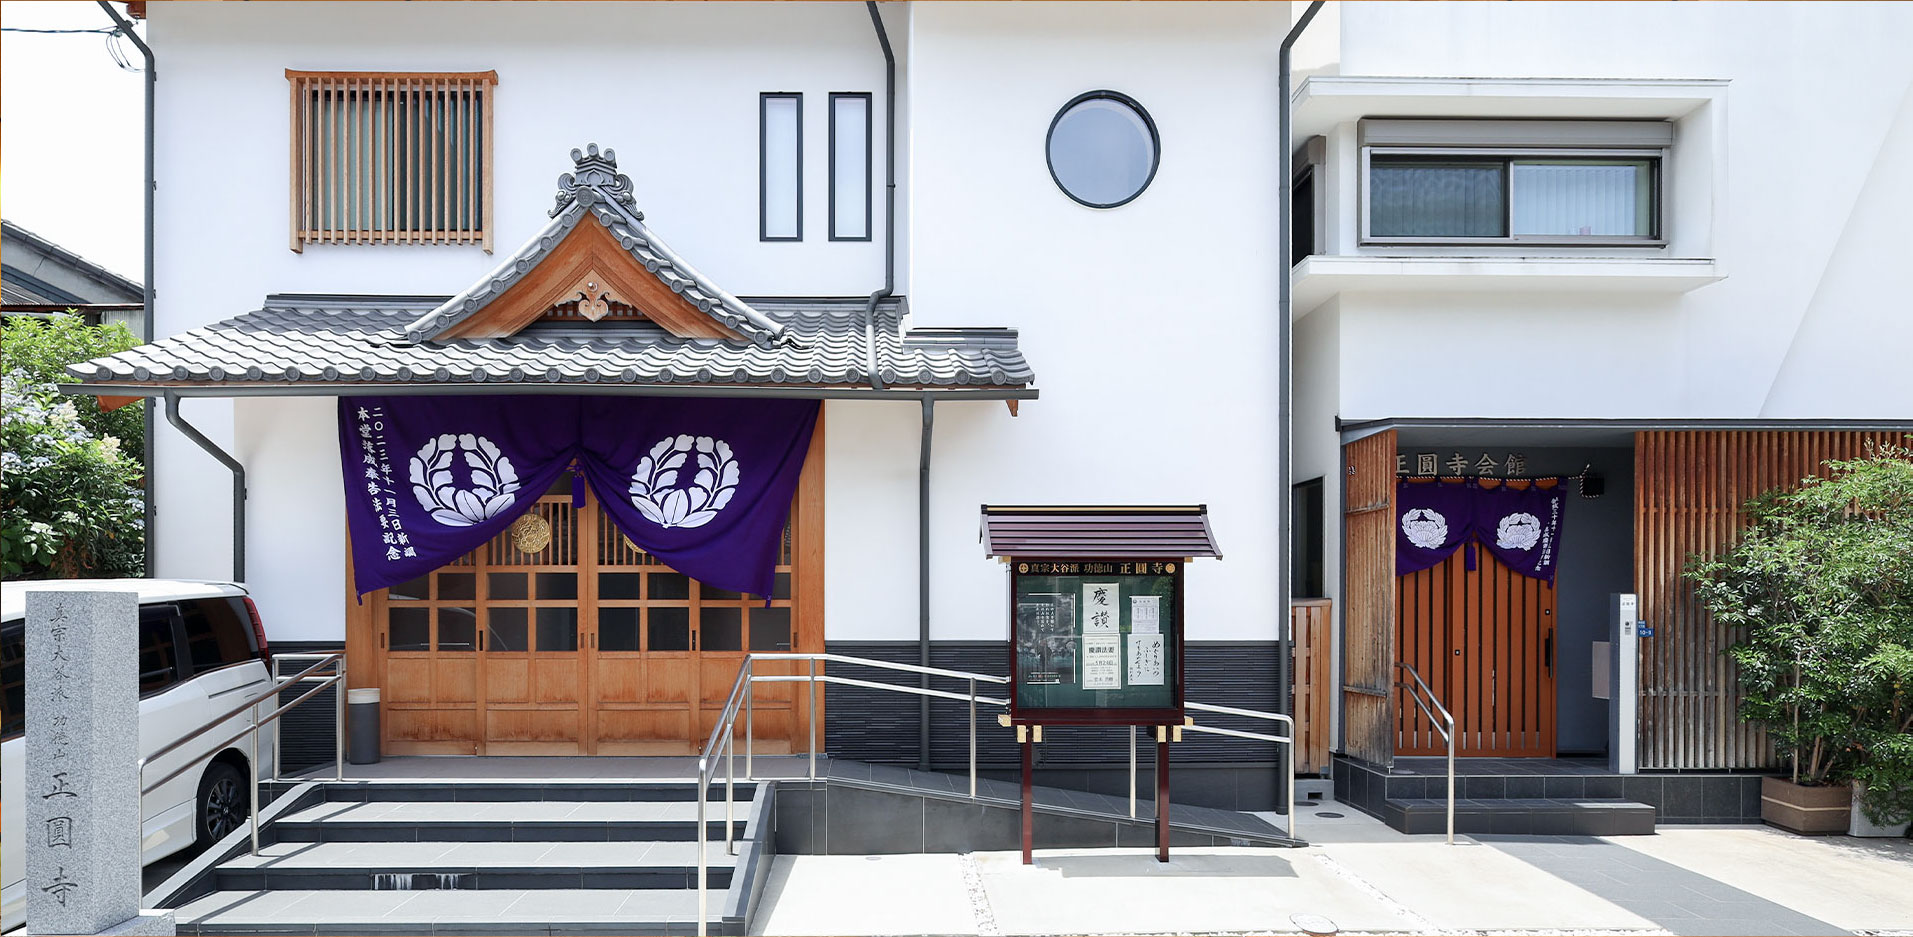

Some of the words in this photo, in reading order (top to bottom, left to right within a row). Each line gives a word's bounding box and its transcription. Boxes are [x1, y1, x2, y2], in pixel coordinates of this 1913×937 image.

[1031, 563, 1080, 574] 真宗大谷派
[1120, 563, 1163, 575] 正圓寺
[50, 602, 69, 702] 真宗大谷派
[41, 772, 78, 907] 正圓寺
